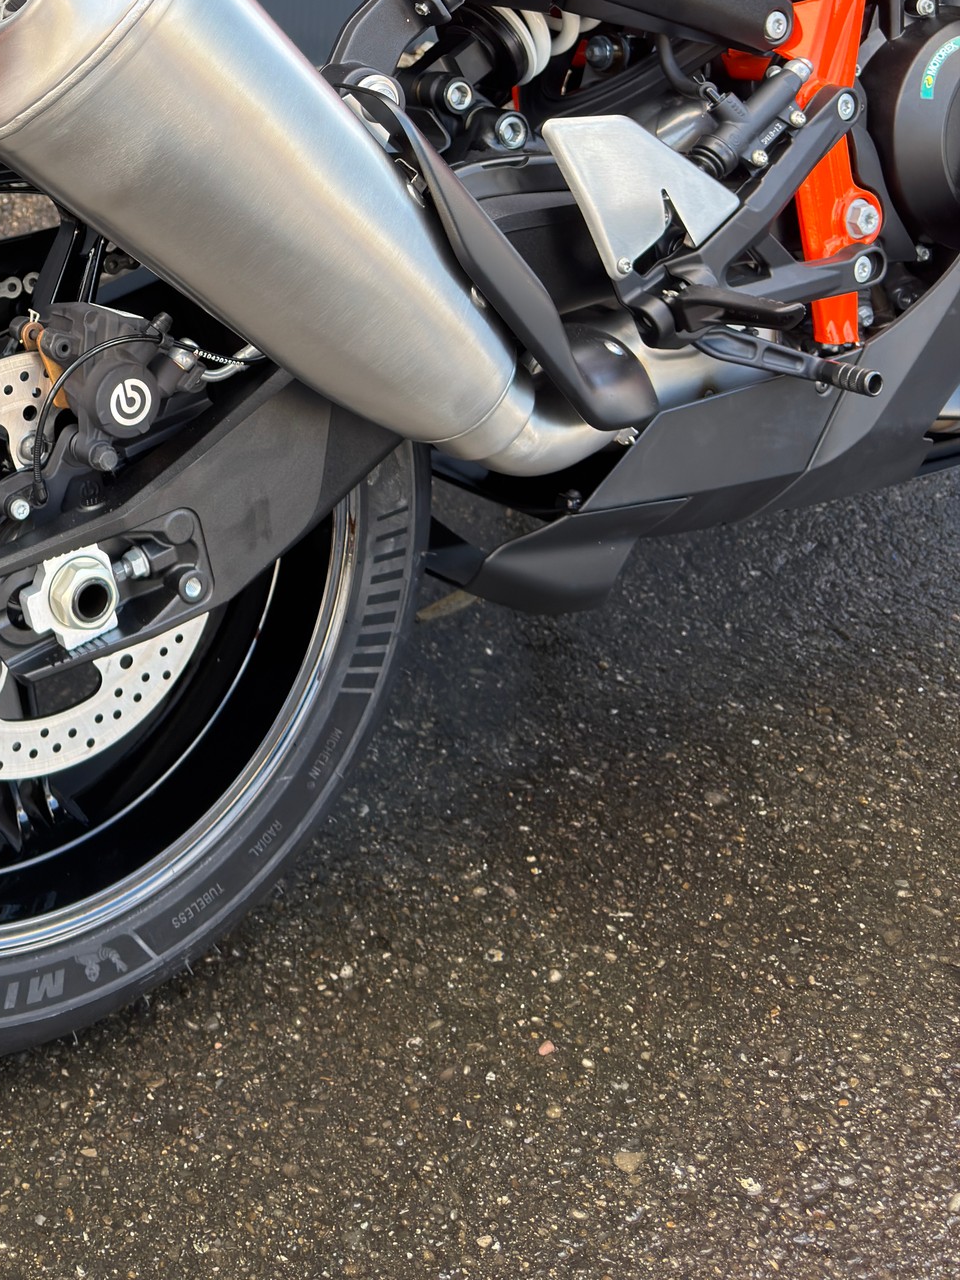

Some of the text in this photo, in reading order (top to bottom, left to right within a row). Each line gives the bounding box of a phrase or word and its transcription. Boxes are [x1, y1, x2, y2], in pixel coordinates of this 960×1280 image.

[926, 41, 959, 76] MOTOREX
[307, 727, 343, 780] MICHELIN
[248, 819, 283, 857] RADIAL
[171, 883, 225, 928] TUBELESS
